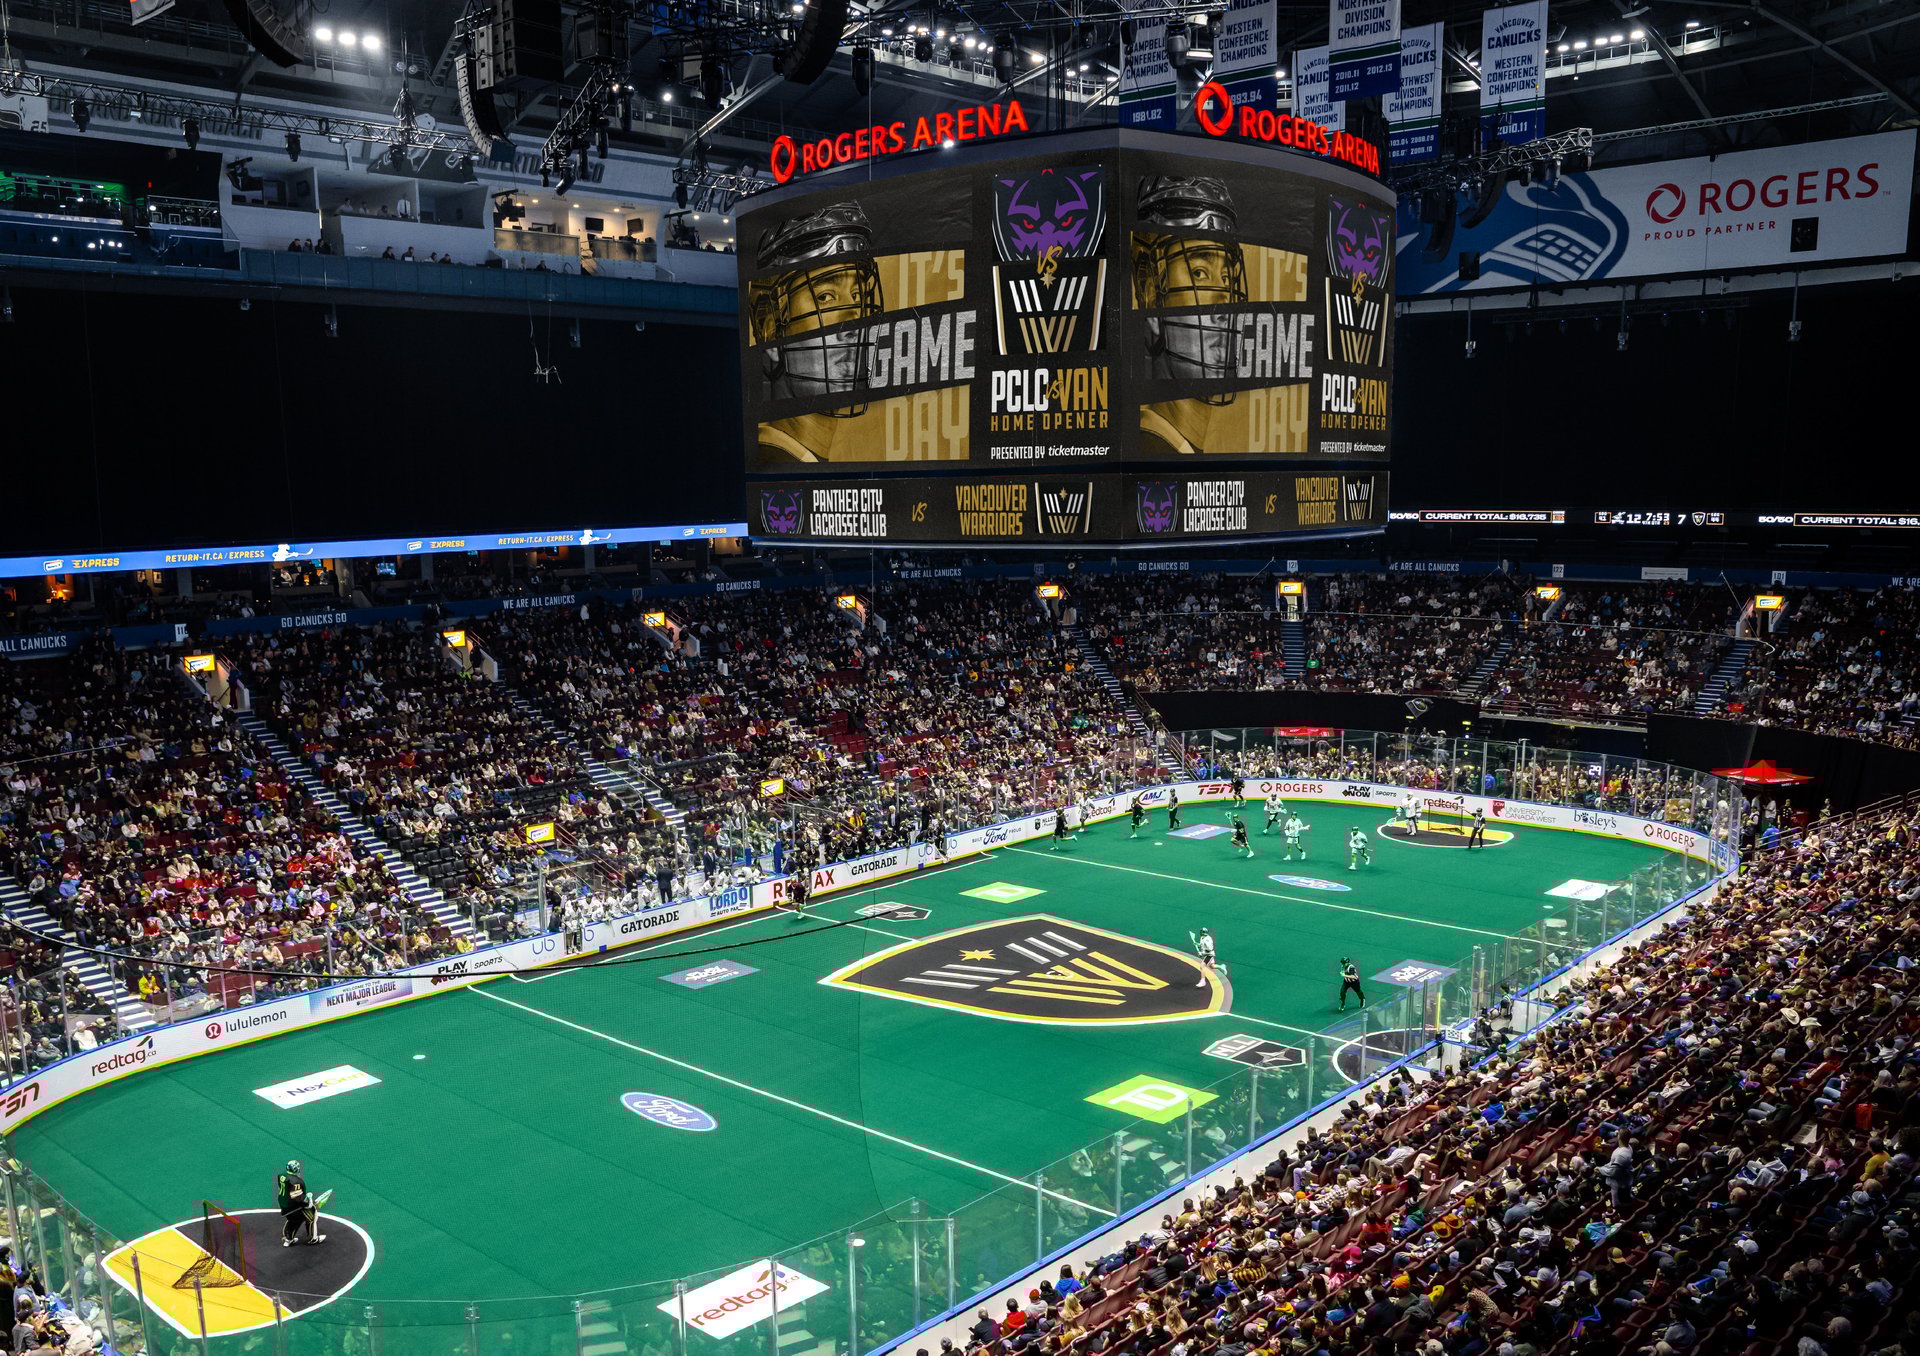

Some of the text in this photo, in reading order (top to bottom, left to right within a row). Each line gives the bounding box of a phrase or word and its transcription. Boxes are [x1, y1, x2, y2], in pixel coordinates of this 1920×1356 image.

[1345, 6, 1385, 24] DIVISION
[1225, 17, 1263, 36] WESTERN
[1337, 19, 1391, 40] CHAMPIONS
[1494, 18, 1535, 34] VANCOUVER
[1218, 30, 1269, 49] CONFERENCE
[1487, 29, 1541, 49] CANUCKS
[1220, 43, 1268, 63] CHAMPIONS
[1401, 50, 1437, 67] NUCKS
[1494, 54, 1533, 70] WESTERN
[1297, 70, 1329, 86] CANUC
[1487, 65, 1538, 83] CONFERENCE
[1489, 79, 1537, 96] CHAMPIONS
[1230, 89, 1262, 106] 993.94
[1304, 92, 1329, 105] SMYTH
[1389, 97, 1433, 113] CHAMPIONS
[1303, 103, 1334, 116] DIVISION
[803, 99, 1029, 174] ROGERS ARENA
[1497, 121, 1528, 136] 2010.11
[1238, 105, 1380, 176] ROGERS ARENA
[1698, 162, 1879, 216] ROGERS
[1644, 220, 1777, 242] PROUD PARTNER
[1036, 246, 1063, 275] VS
[900, 249, 965, 309] IT'S
[1259, 246, 1309, 302] IT'S
[868, 309, 977, 389] GAME
[1235, 312, 1315, 379] GAME
[991, 368, 1049, 413] PCLC
[1057, 366, 1109, 412] VAN
[1321, 372, 1357, 413] PCLC
[1360, 376, 1388, 418] VAN
[884, 384, 971, 462] DAY
[990, 410, 1109, 432] HOME OPENER
[1248, 382, 1310, 453] DAY
[1320, 413, 1387, 431] HOME OPENER
[990, 444, 1110, 460] PRESENTED BY ticketmaster
[1320, 441, 1387, 453] PRESENTED BY ticketmaster
[955, 484, 1027, 512] VANCOUVER
[1187, 480, 1245, 507] PANTHER CITY
[1295, 477, 1339, 502] VANCOUVER
[812, 489, 883, 511] PANTHER CITY
[1183, 506, 1247, 532] LACROSSE CLUB
[1297, 501, 1337, 526] WARRIORS
[1389, 512, 1419, 521] 50/50
[1425, 512, 1472, 521] CURRENT
[1473, 513, 1508, 521] TOTAL:
[1626, 514, 1641, 524] 12
[1646, 512, 1670, 521] 7:53
[1677, 514, 1686, 525] 7
[1801, 516, 1855, 524] CURRENT
[1856, 517, 1897, 525] TOTAL:
[809, 513, 887, 537] LACROSSE CLUB
[959, 512, 1023, 536] WARRIORS
[429, 539, 465, 549] EXPRESS
[72, 557, 120, 569] EXPRESS
[1138, 562, 1189, 571] GO CANUCKS GO
[1400, 562, 1413, 571] ARE
[1414, 562, 1426, 571] ALL
[1428, 562, 1460, 572] CANUCKS
[900, 568, 962, 579] WE ARE ALL CANUCKS
[1892, 577, 1920, 586] WE ARE
[716, 580, 761, 592] GO CANUCKS GO
[503, 594, 576, 610] WE ARE ALL CANUCKS
[281, 612, 347, 627] GO CANUCKS GO
[20, 635, 67, 650] CANUCKS
[1142, 791, 1163, 802] AMJ
[1275, 783, 1323, 794] ROGERS
[1347, 790, 1371, 798] NOW
[1375, 790, 1397, 798] SPORTS
[1504, 812, 1557, 824] CANADA WEST
[1505, 806, 1546, 816] UNIVERSITY
[983, 827, 1009, 845] Ford
[1656, 827, 1695, 848] ROGERS
[851, 856, 898, 876] GATORADE
[620, 911, 681, 934] GATORADE
[437, 956, 504, 974] PLAY SPORTS
[326, 981, 397, 1007] NEXT MAJOR LEAGUE
[225, 1009, 287, 1033] lululemon
[1107, 1083, 1189, 1111] TD
[633, 1099, 700, 1125] Ford
